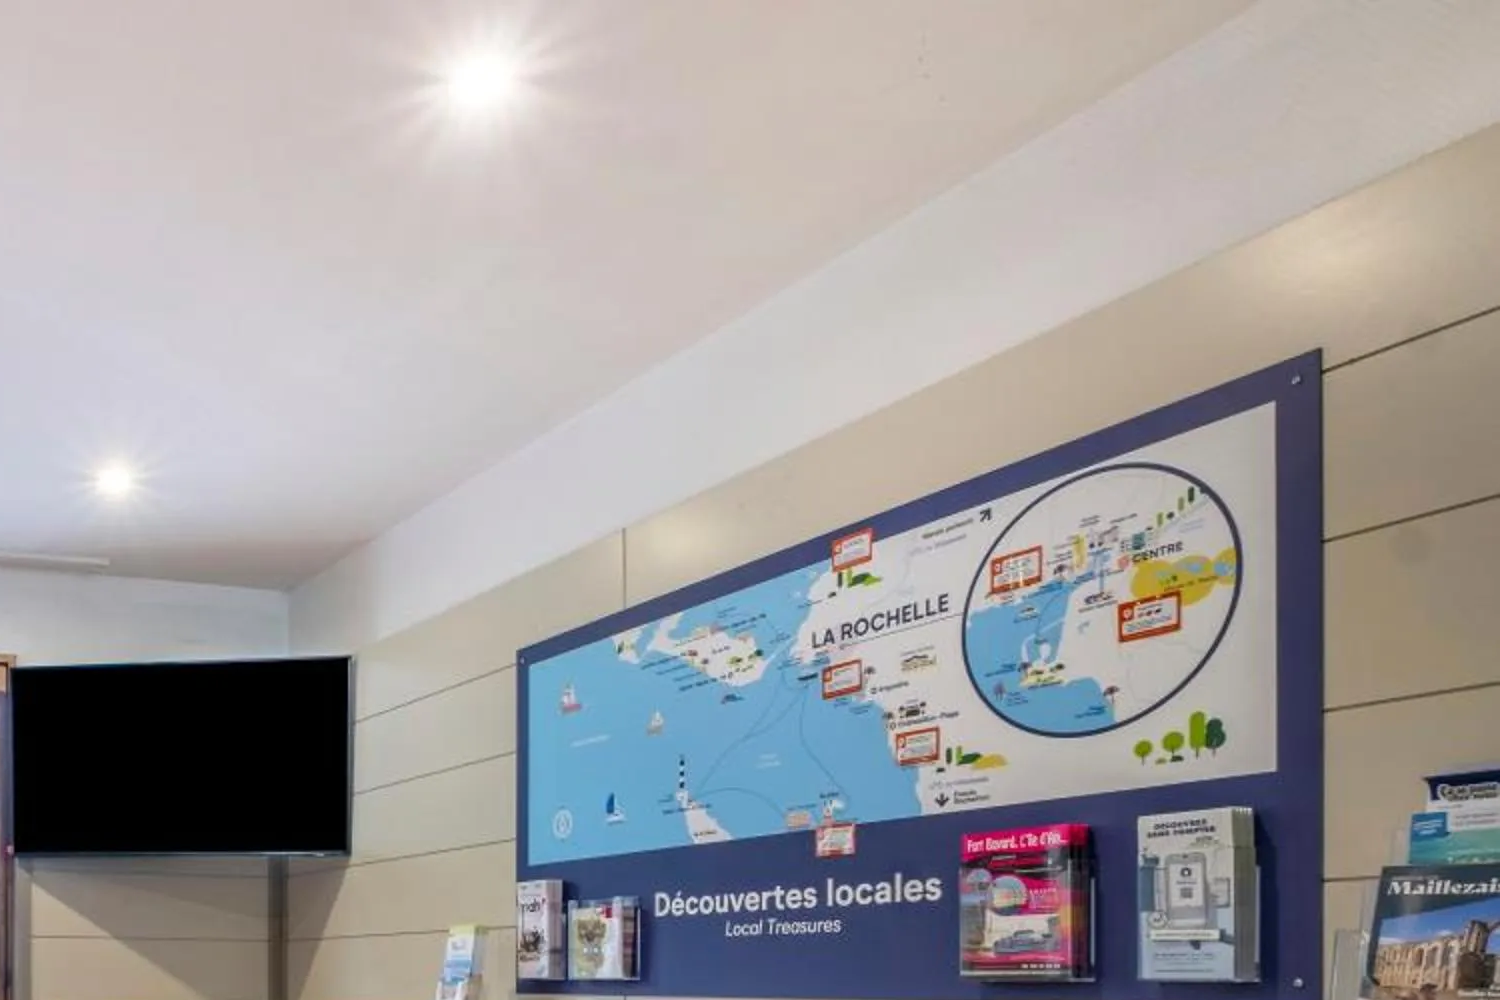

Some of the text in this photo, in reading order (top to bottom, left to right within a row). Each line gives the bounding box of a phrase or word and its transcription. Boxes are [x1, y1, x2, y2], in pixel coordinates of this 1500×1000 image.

[1132, 541, 1184, 563] CENTRE
[811, 593, 949, 649] LA ROCHELLE
[654, 872, 943, 918] Découvertes locales
[725, 918, 842, 938] Local Treasures
